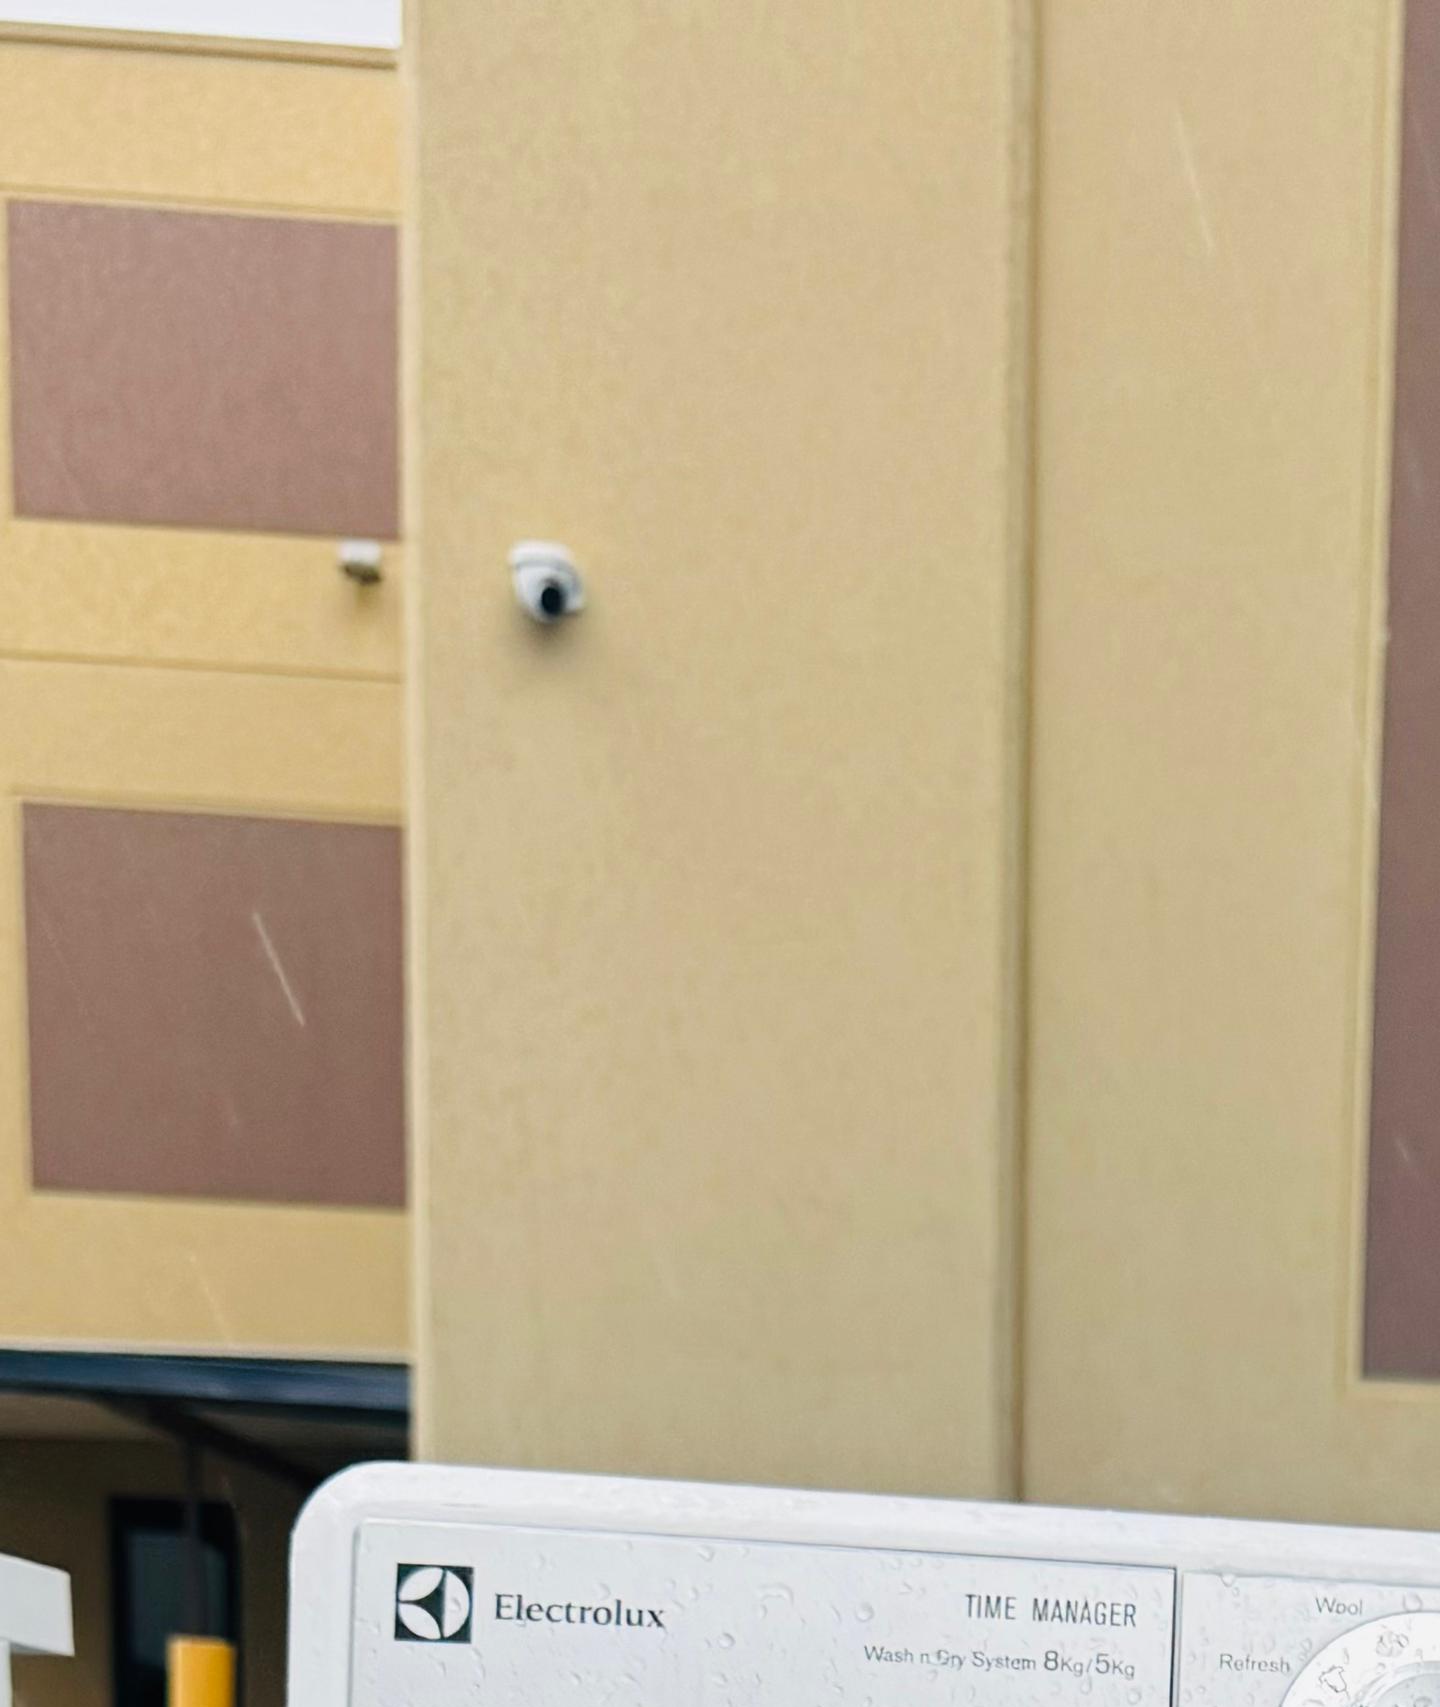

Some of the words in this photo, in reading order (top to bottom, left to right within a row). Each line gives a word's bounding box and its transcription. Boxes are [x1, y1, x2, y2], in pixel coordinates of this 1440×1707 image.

[494, 1592, 665, 1628] Electrolux
[966, 1593, 1017, 1620] TIME
[1031, 1597, 1138, 1628] MANAGER
[1315, 1597, 1364, 1616] Wool
[863, 1644, 914, 1665] Wash
[971, 1651, 1037, 1672] System
[1218, 1653, 1291, 1674] Refresh
